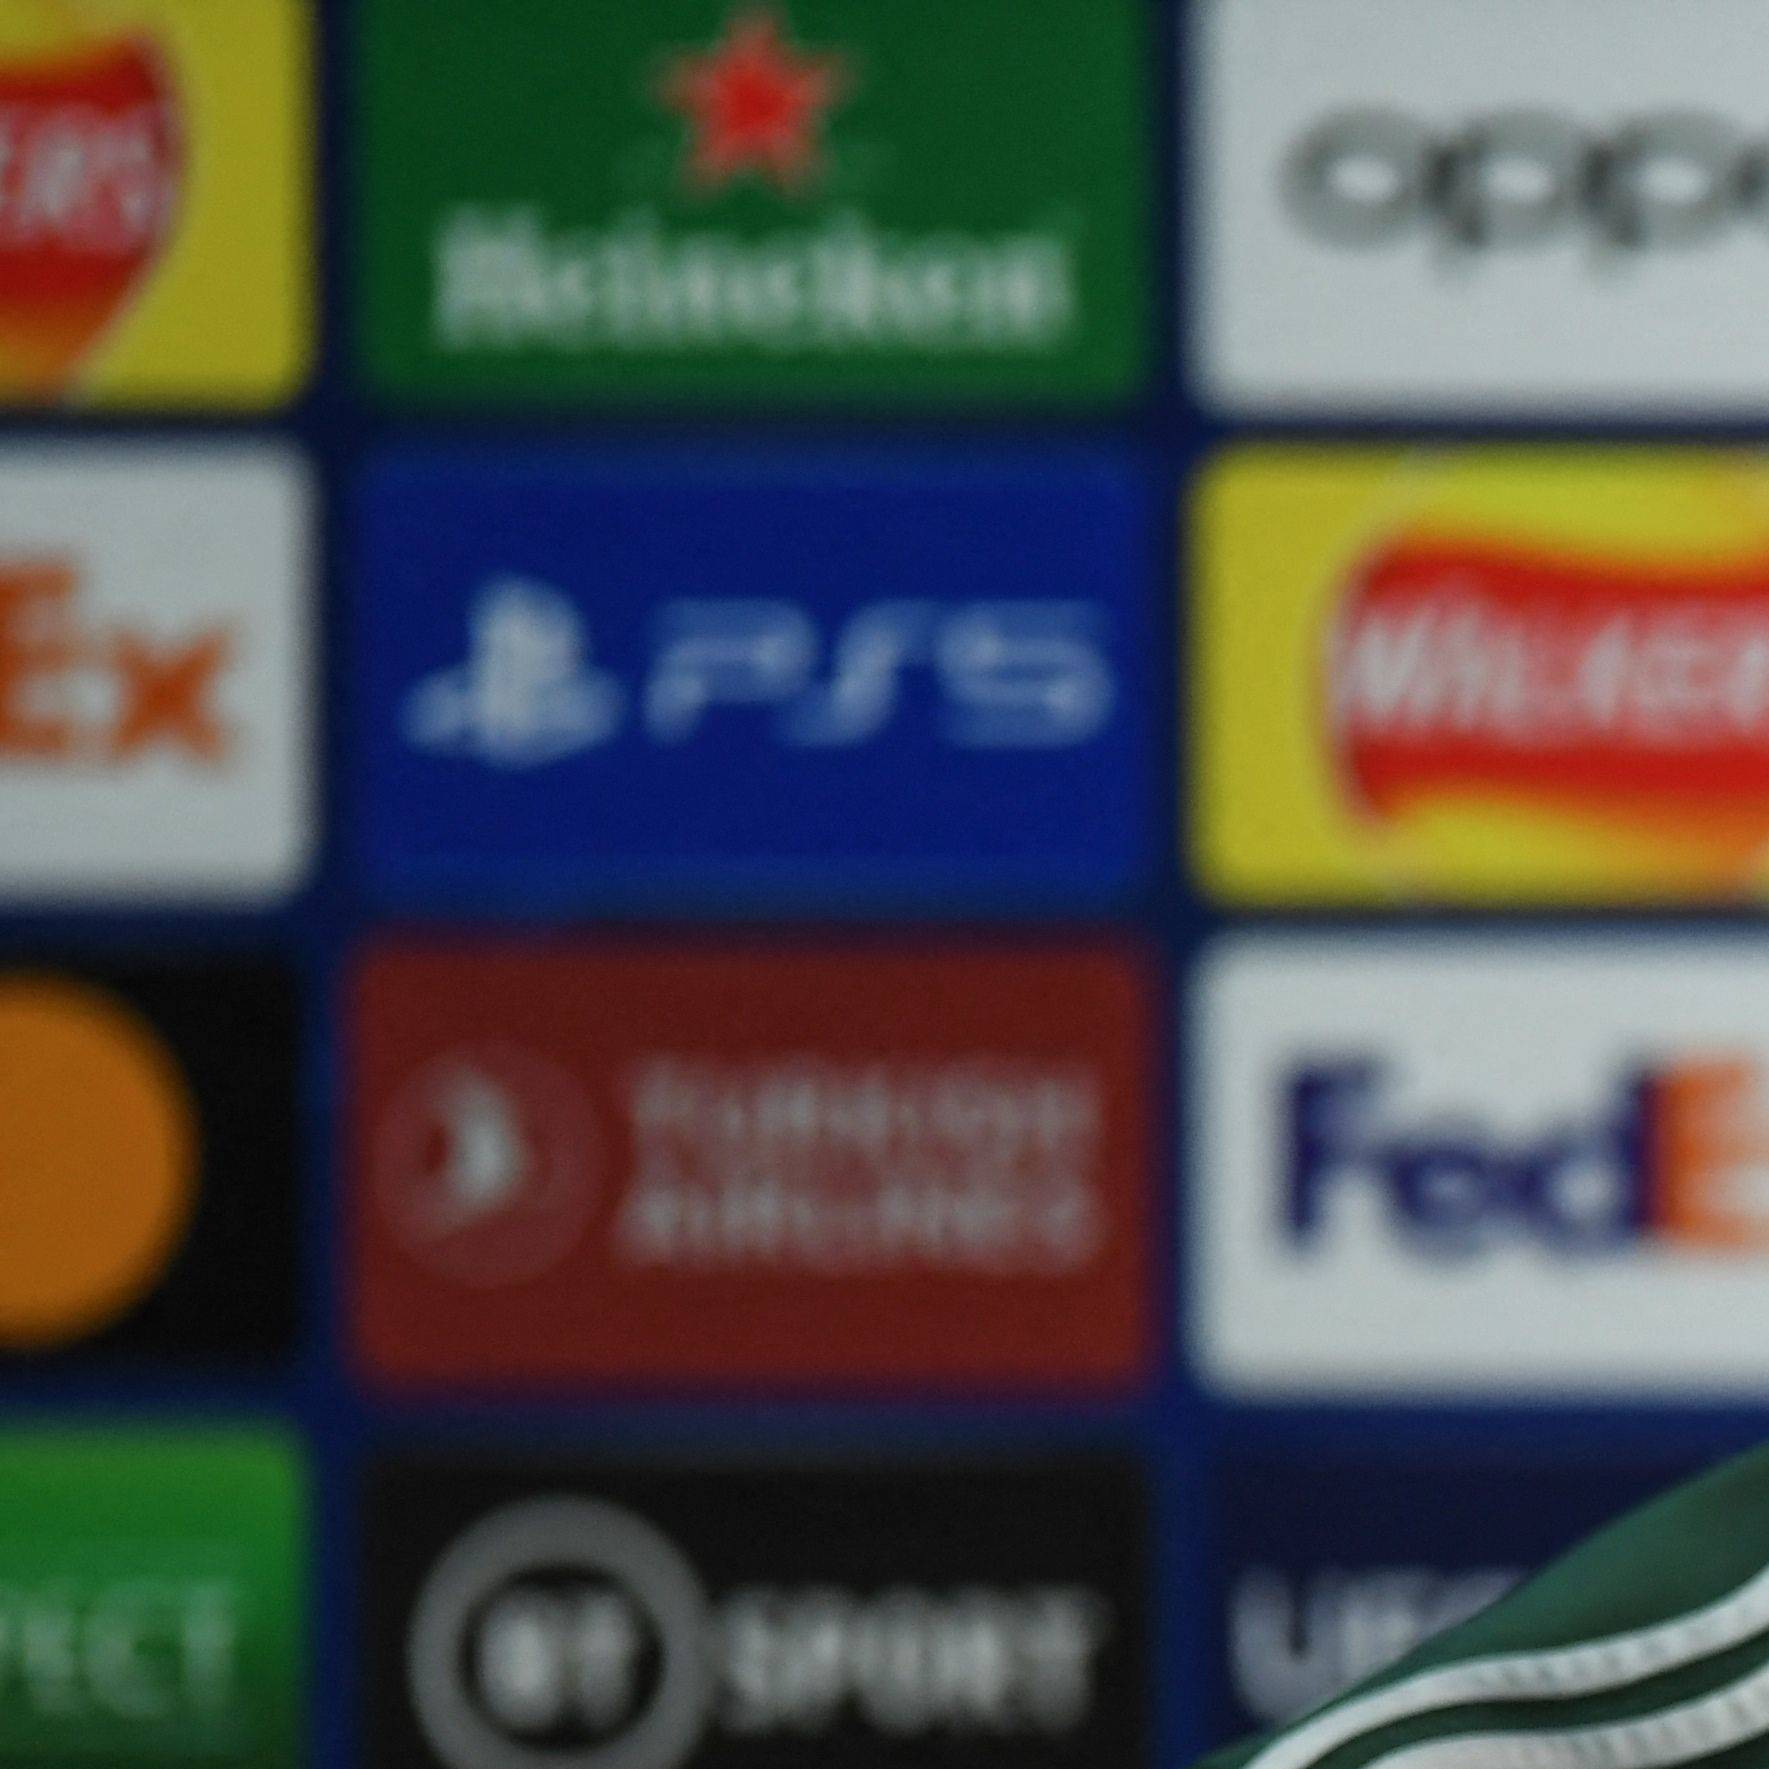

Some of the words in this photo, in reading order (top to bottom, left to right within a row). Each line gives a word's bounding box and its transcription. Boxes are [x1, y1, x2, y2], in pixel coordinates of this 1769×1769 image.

[437, 210, 1073, 346] Heineken
[645, 600, 1112, 748] PS5
[630, 1060, 1098, 1152] TURKISH
[620, 1180, 1100, 1275] AIRLINES
[478, 1592, 637, 1730] BT
[718, 1590, 1101, 1732] SPORT
